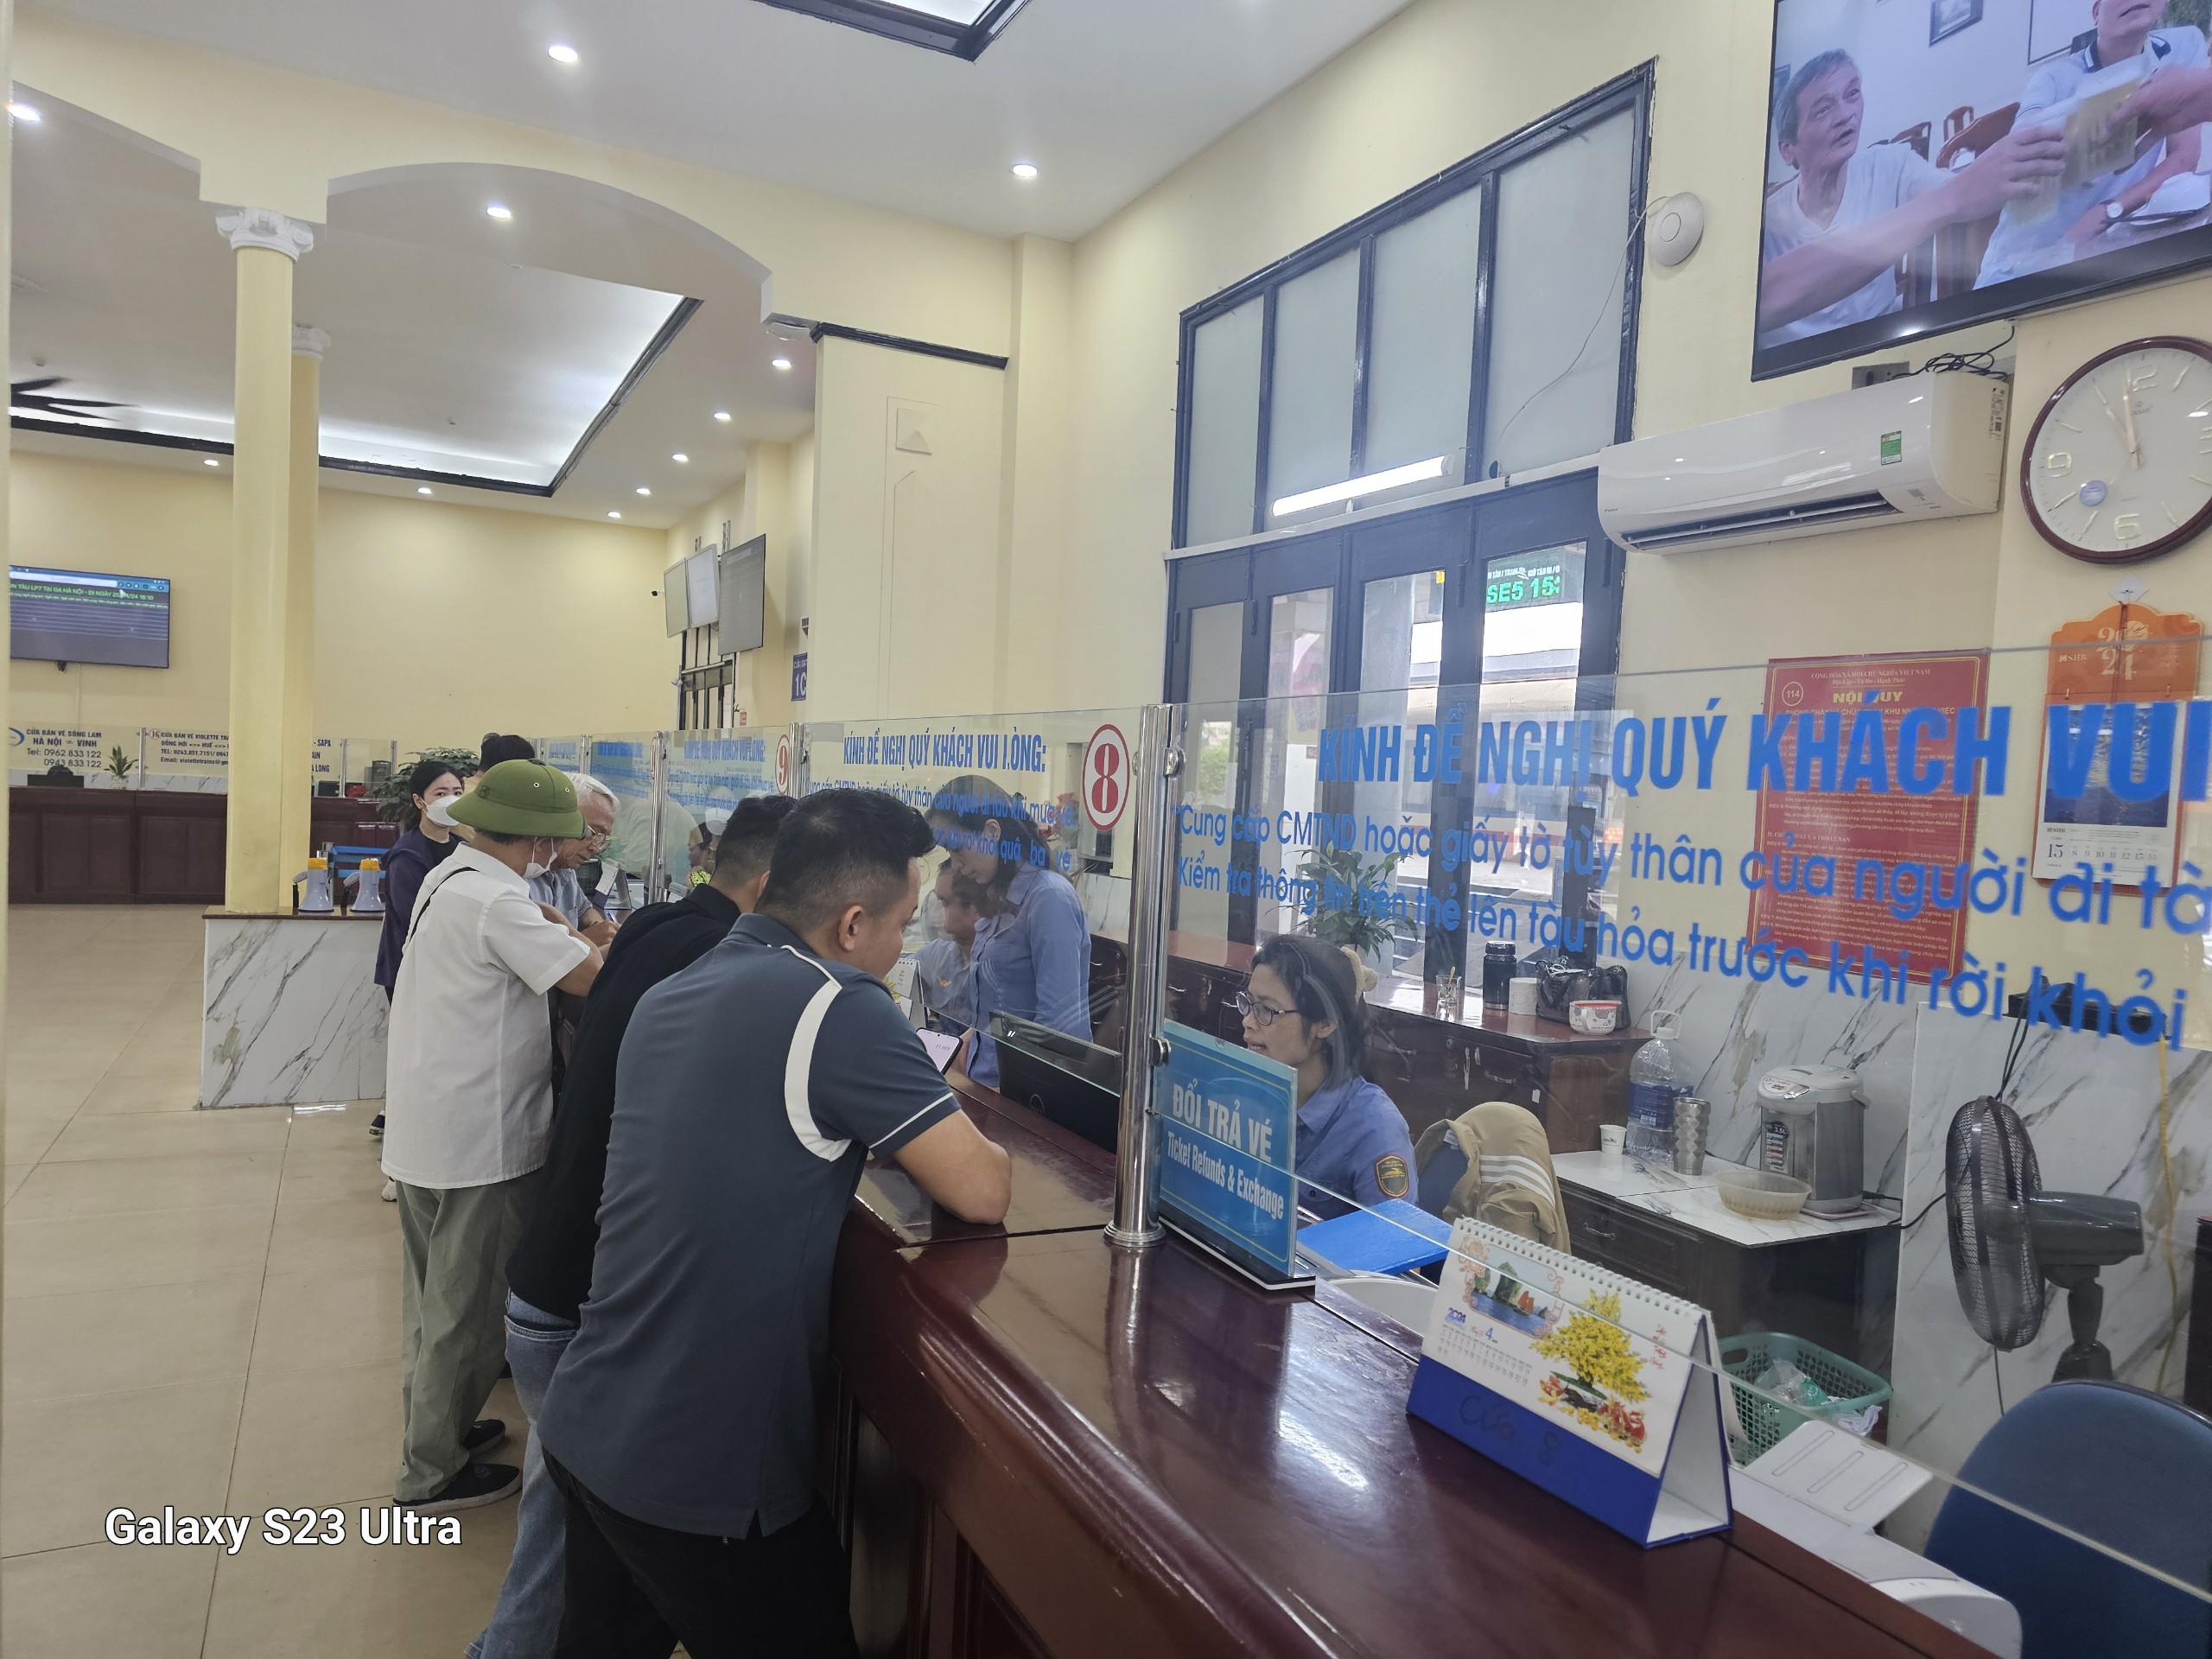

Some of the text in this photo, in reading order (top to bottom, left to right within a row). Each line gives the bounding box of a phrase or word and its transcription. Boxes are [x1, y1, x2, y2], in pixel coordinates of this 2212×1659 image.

[1486, 580, 1524, 604] SE5
[1786, 690, 1801, 699] 114
[1833, 691, 1863, 705] NỘI
[33, 737, 45, 746] HÀ
[47, 738, 62, 747] NỘI
[317, 739, 331, 747] SAPA
[843, 731, 865, 765] KÍNH
[867, 728, 880, 766] ĐỀ
[881, 734, 906, 772] NGHỊ
[908, 728, 930, 769] QUÝ
[932, 727, 973, 768] KHÁCH
[977, 734, 999, 770] VUI
[1319, 715, 1402, 782] KÍNH
[1413, 702, 1466, 784] ĐỀ
[1478, 719, 1594, 803] NGHỊ
[1611, 697, 1727, 798] QUÝ
[1746, 690, 2012, 796] KHÁCH
[2048, 701, 2212, 802] VUI
[315, 764, 330, 772] LONG
[779, 745, 790, 785] 9
[1091, 743, 1120, 813] 8
[915, 785, 932, 807] thân
[1011, 796, 1027, 821] khi
[1180, 804, 1227, 846] Cung
[1231, 805, 1270, 851] cấp
[1276, 810, 1357, 850] CMTND
[1441, 814, 1509, 874] giấy
[1519, 823, 1551, 870] tờ
[1563, 824, 1618, 887] tùy
[1630, 832, 1722, 887] thân
[1739, 831, 1836, 898] của
[1854, 847, 2027, 921] người
[2048, 861, 2113, 925] đi
[2047, 844, 2063, 858] 15
[1179, 849, 1220, 892] Kiểm
[1226, 861, 1251, 897] tra
[1257, 866, 1318, 916] thông
[1324, 873, 1351, 913] tin
[1359, 879, 1406, 922] trên
[1416, 882, 1461, 931] thẻ
[1469, 893, 1516, 941] lên
[1529, 899, 1585, 953] tàu
[1596, 906, 1675, 967] hỏa
[1688, 922, 1809, 988] trước
[1827, 939, 1910, 1006] khi
[1928, 951, 2006, 1021] rời
[2027, 966, 2188, 1052] khỏi
[1173, 1079, 1273, 1163] ĐỔI TRẢ VÉ
[1167, 1131, 1284, 1220] Ticket Refunds & Exchange
[1485, 1327, 1494, 1340] 4
